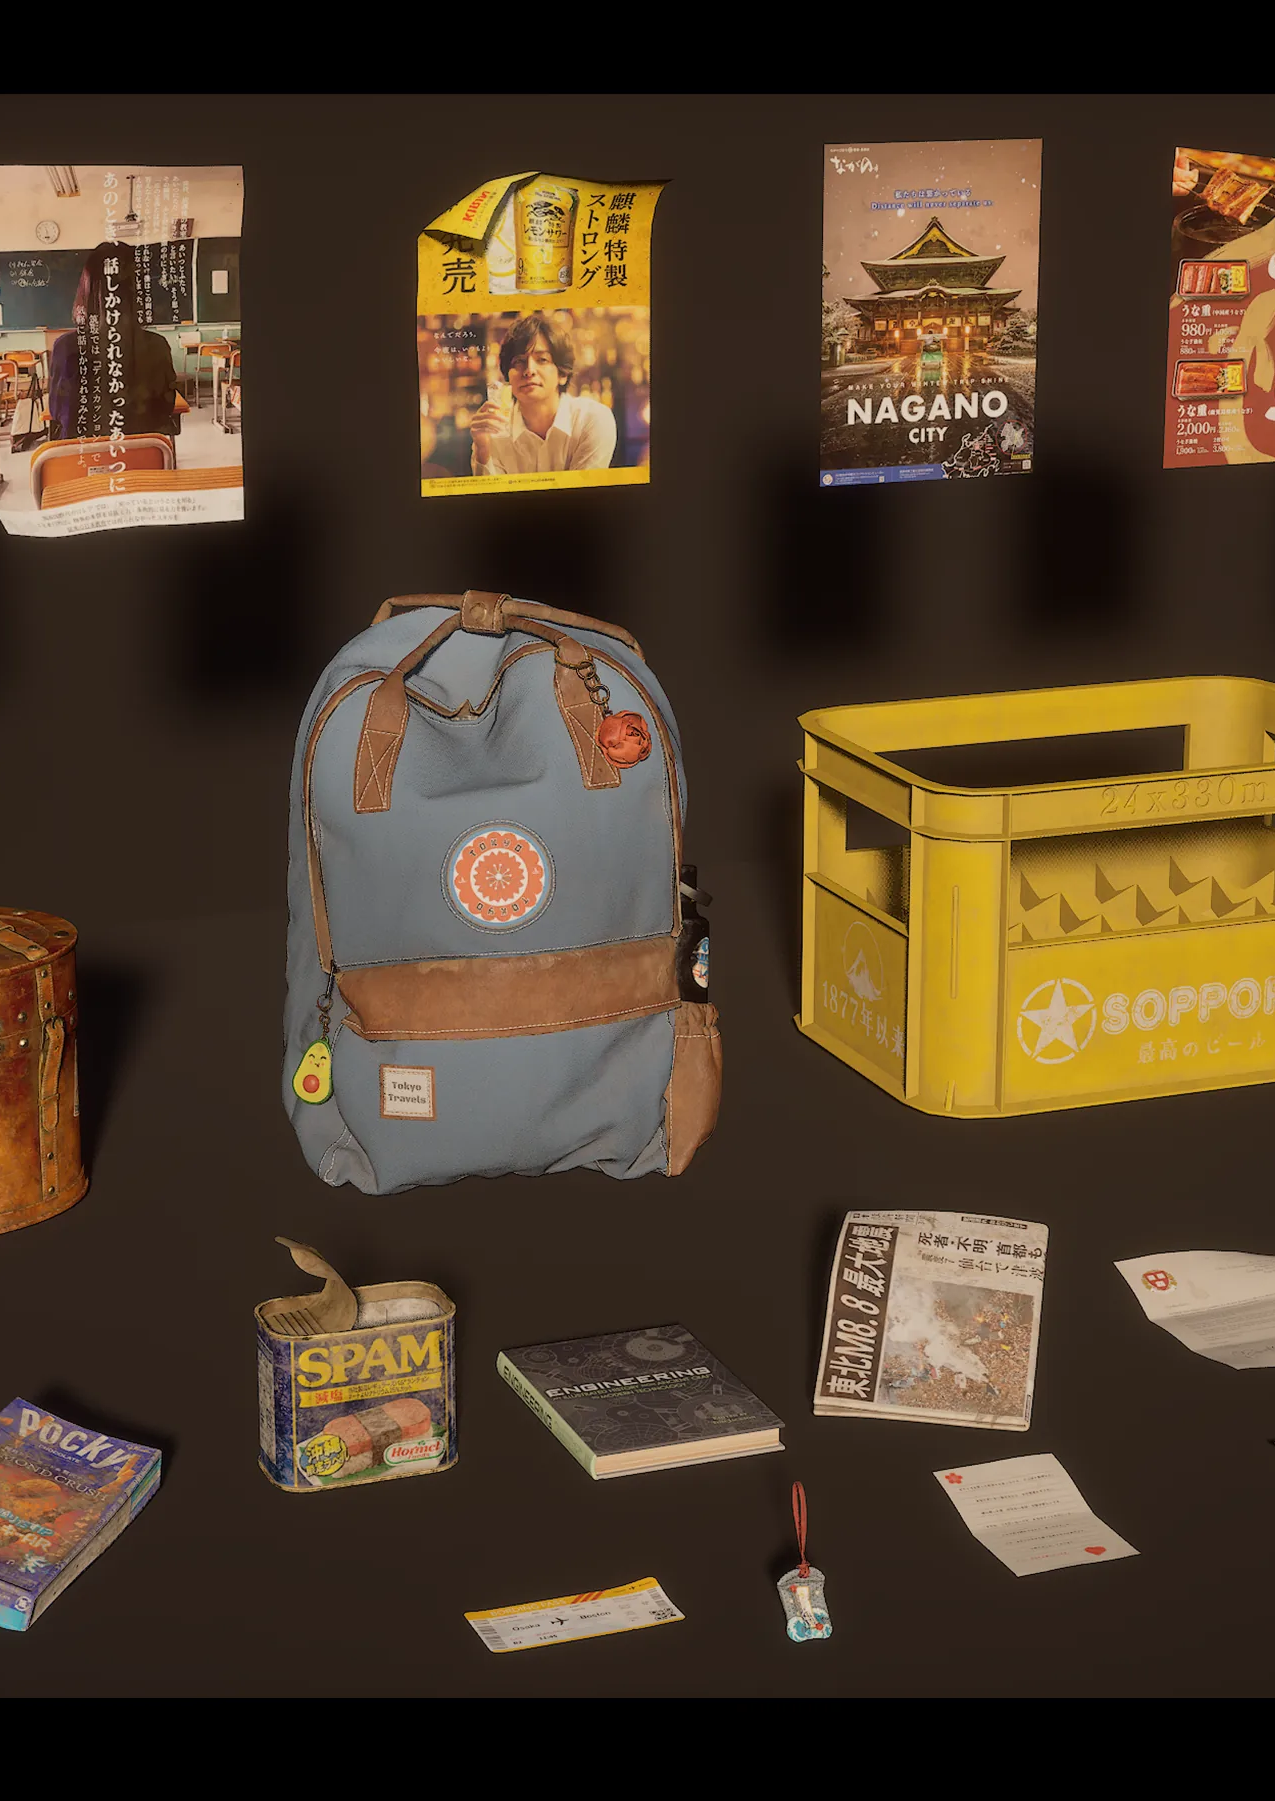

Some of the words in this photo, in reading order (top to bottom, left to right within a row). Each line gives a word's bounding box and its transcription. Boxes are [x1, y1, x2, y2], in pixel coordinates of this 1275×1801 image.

[871, 202, 905, 210] Distance
[949, 200, 980, 209] separate
[579, 193, 605, 290] ストロング
[1182, 304, 1211, 317] うな重
[848, 383, 874, 391] MAKE
[880, 381, 905, 390] YOUR
[953, 378, 976, 386] TRIP
[981, 377, 1009, 385] SHINE
[847, 390, 1008, 425] NAGANO
[1178, 404, 1207, 418] うな重
[908, 426, 949, 443] CITY
[469, 838, 522, 857] TOKYO
[476, 896, 529, 915] TOKYO
[822, 980, 905, 1059] 1877年以来
[1136, 1034, 1267, 1066] 最高のビール
[392, 1081, 422, 1093] Tokyo
[388, 1093, 427, 1104] Travels
[297, 1329, 444, 1388] SPAM
[545, 1366, 711, 1398] ENGINEERING
[391, 1440, 441, 1459] Hormel
[55, 1475, 110, 1501] CRUSH
[512, 1623, 541, 1632] Osaka
[580, 1611, 611, 1620] Boston
